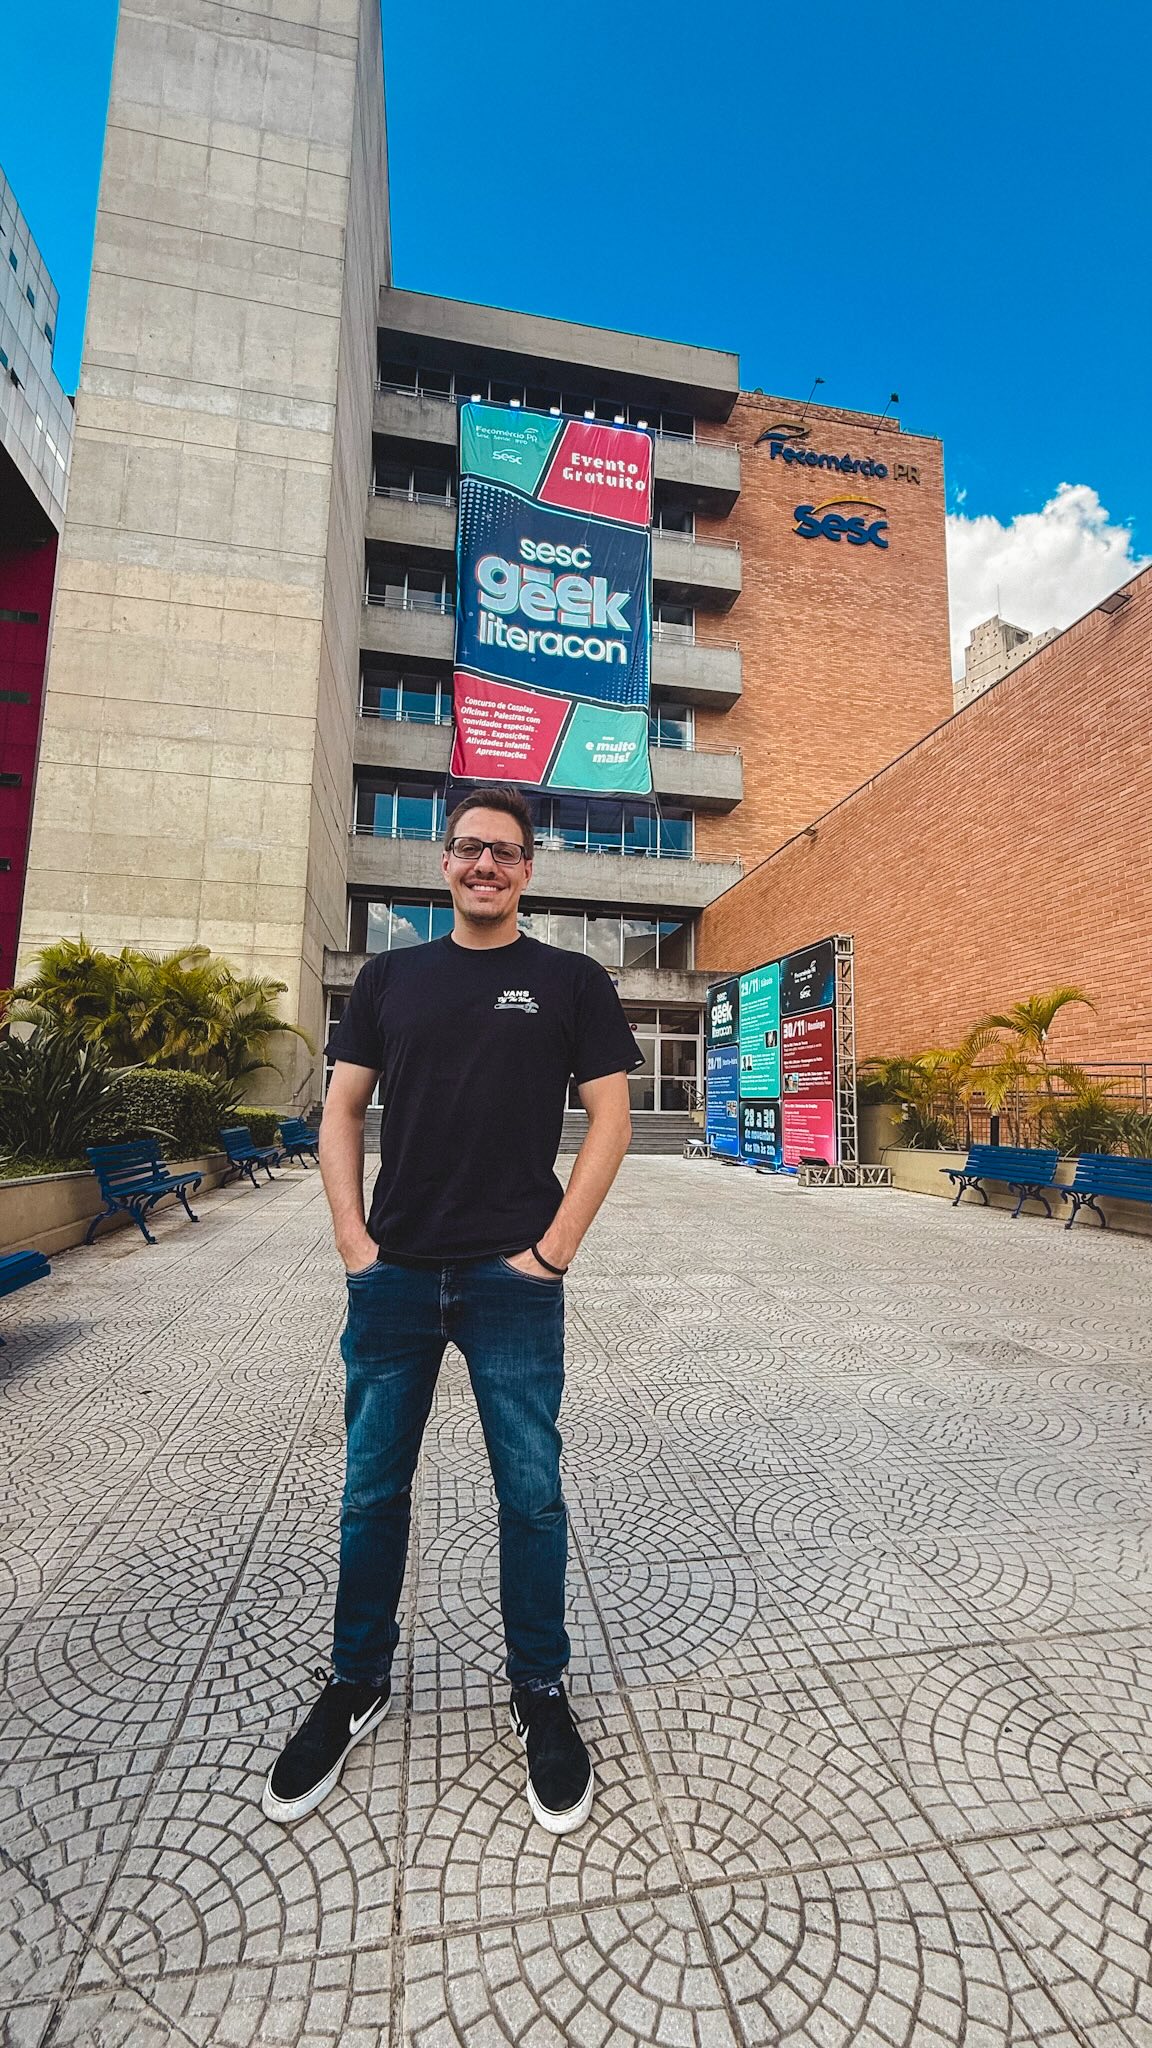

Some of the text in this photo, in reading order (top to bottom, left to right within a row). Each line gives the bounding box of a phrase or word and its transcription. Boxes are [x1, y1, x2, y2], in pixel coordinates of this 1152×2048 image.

[476, 425, 538, 443] Fecomércio PR
[571, 452, 639, 475] Evento
[770, 441, 921, 486] Fecomércio PR
[562, 467, 646, 492] Gratuito
[519, 537, 592, 570] sesc
[476, 554, 633, 632] geek
[478, 610, 628, 665] literacon
[464, 696, 534, 714] Concurso de Cosplay
[460, 706, 541, 724] Oficinas Palestras com
[462, 717, 535, 732] convidados especiais
[465, 727, 530, 741] Jogos Exposições
[465, 736, 504, 748] Atividades
[475, 747, 528, 760] Apresentações
[585, 741, 637, 752] e muito
[592, 751, 631, 764] mais!
[503, 990, 530, 998] VANS
[783, 1019, 805, 1039] 30/11
[744, 1108, 755, 1127] 28
[756, 1111, 763, 1128] a
[763, 1108, 776, 1129] 30
